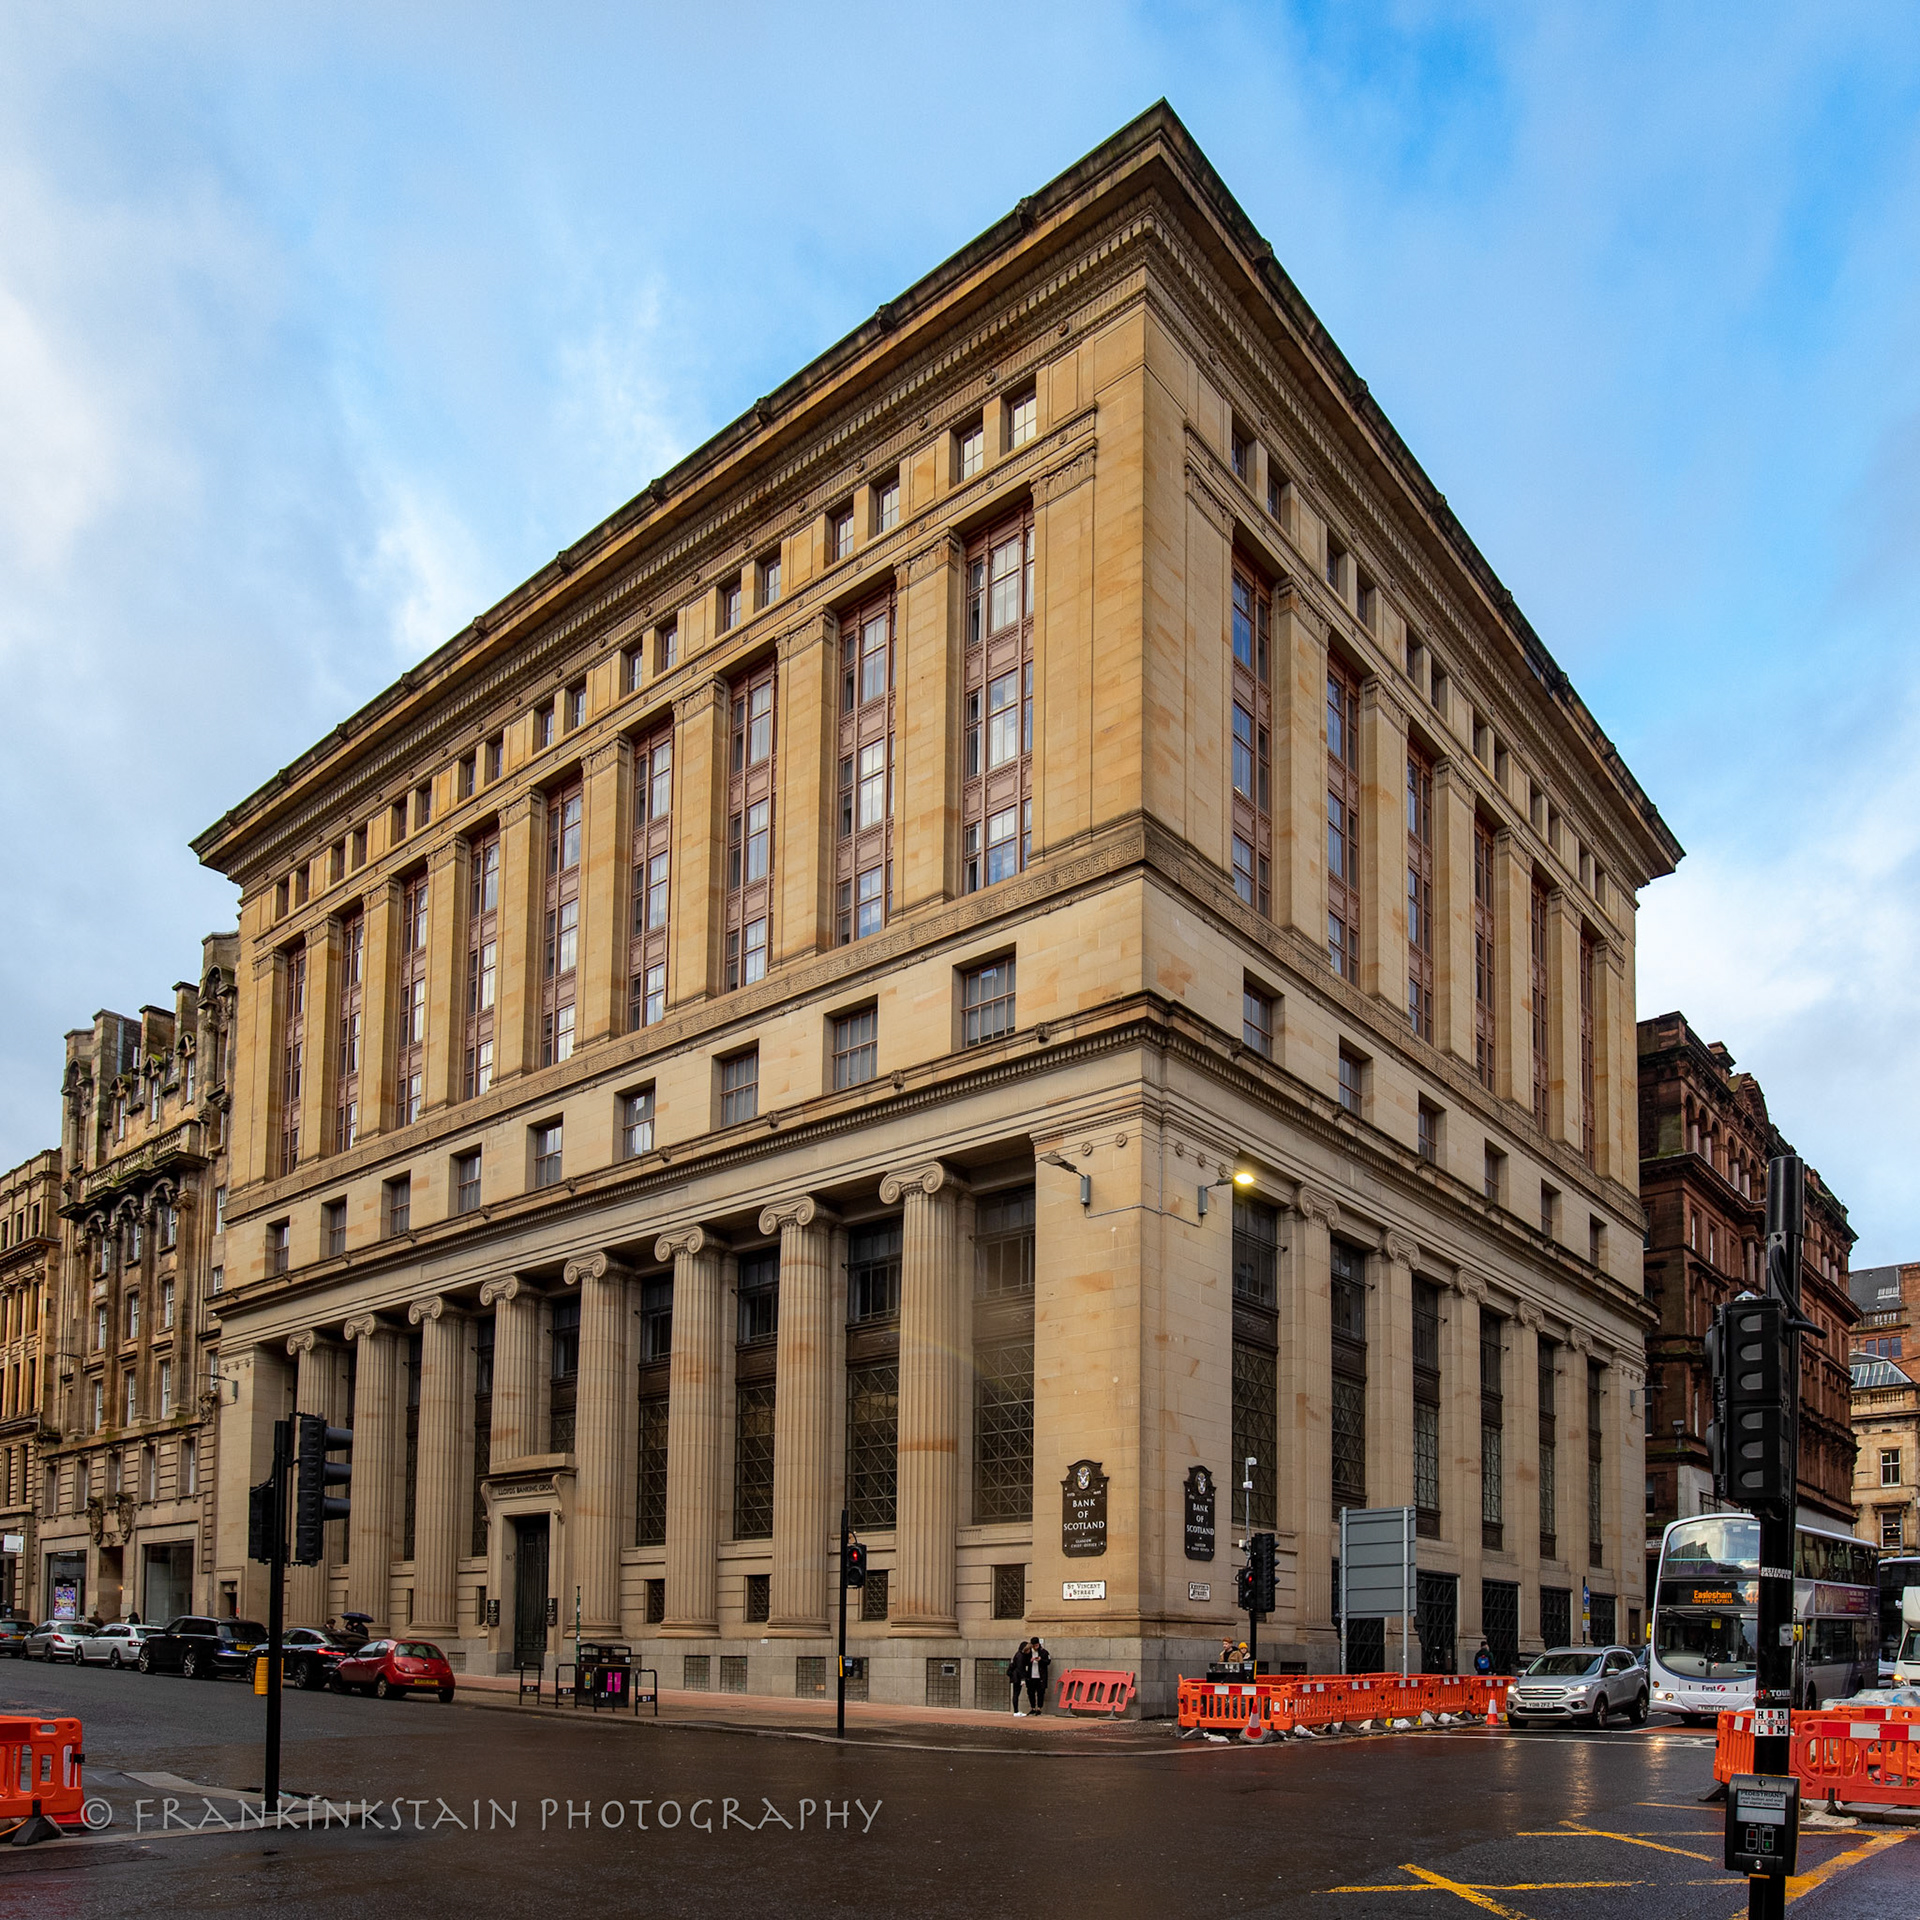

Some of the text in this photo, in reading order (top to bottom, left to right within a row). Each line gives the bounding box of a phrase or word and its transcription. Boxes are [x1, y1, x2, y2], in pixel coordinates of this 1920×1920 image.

[1072, 1499, 1096, 1508] BANK
[1193, 1503, 1208, 1512] BANK
[1077, 1511, 1089, 1519] OF
[1063, 1520, 1105, 1531] SCOTLAND
[1186, 1525, 1214, 1535] SCOTLAND
[1740, 1790, 1784, 1799] PEDESTRIANS
